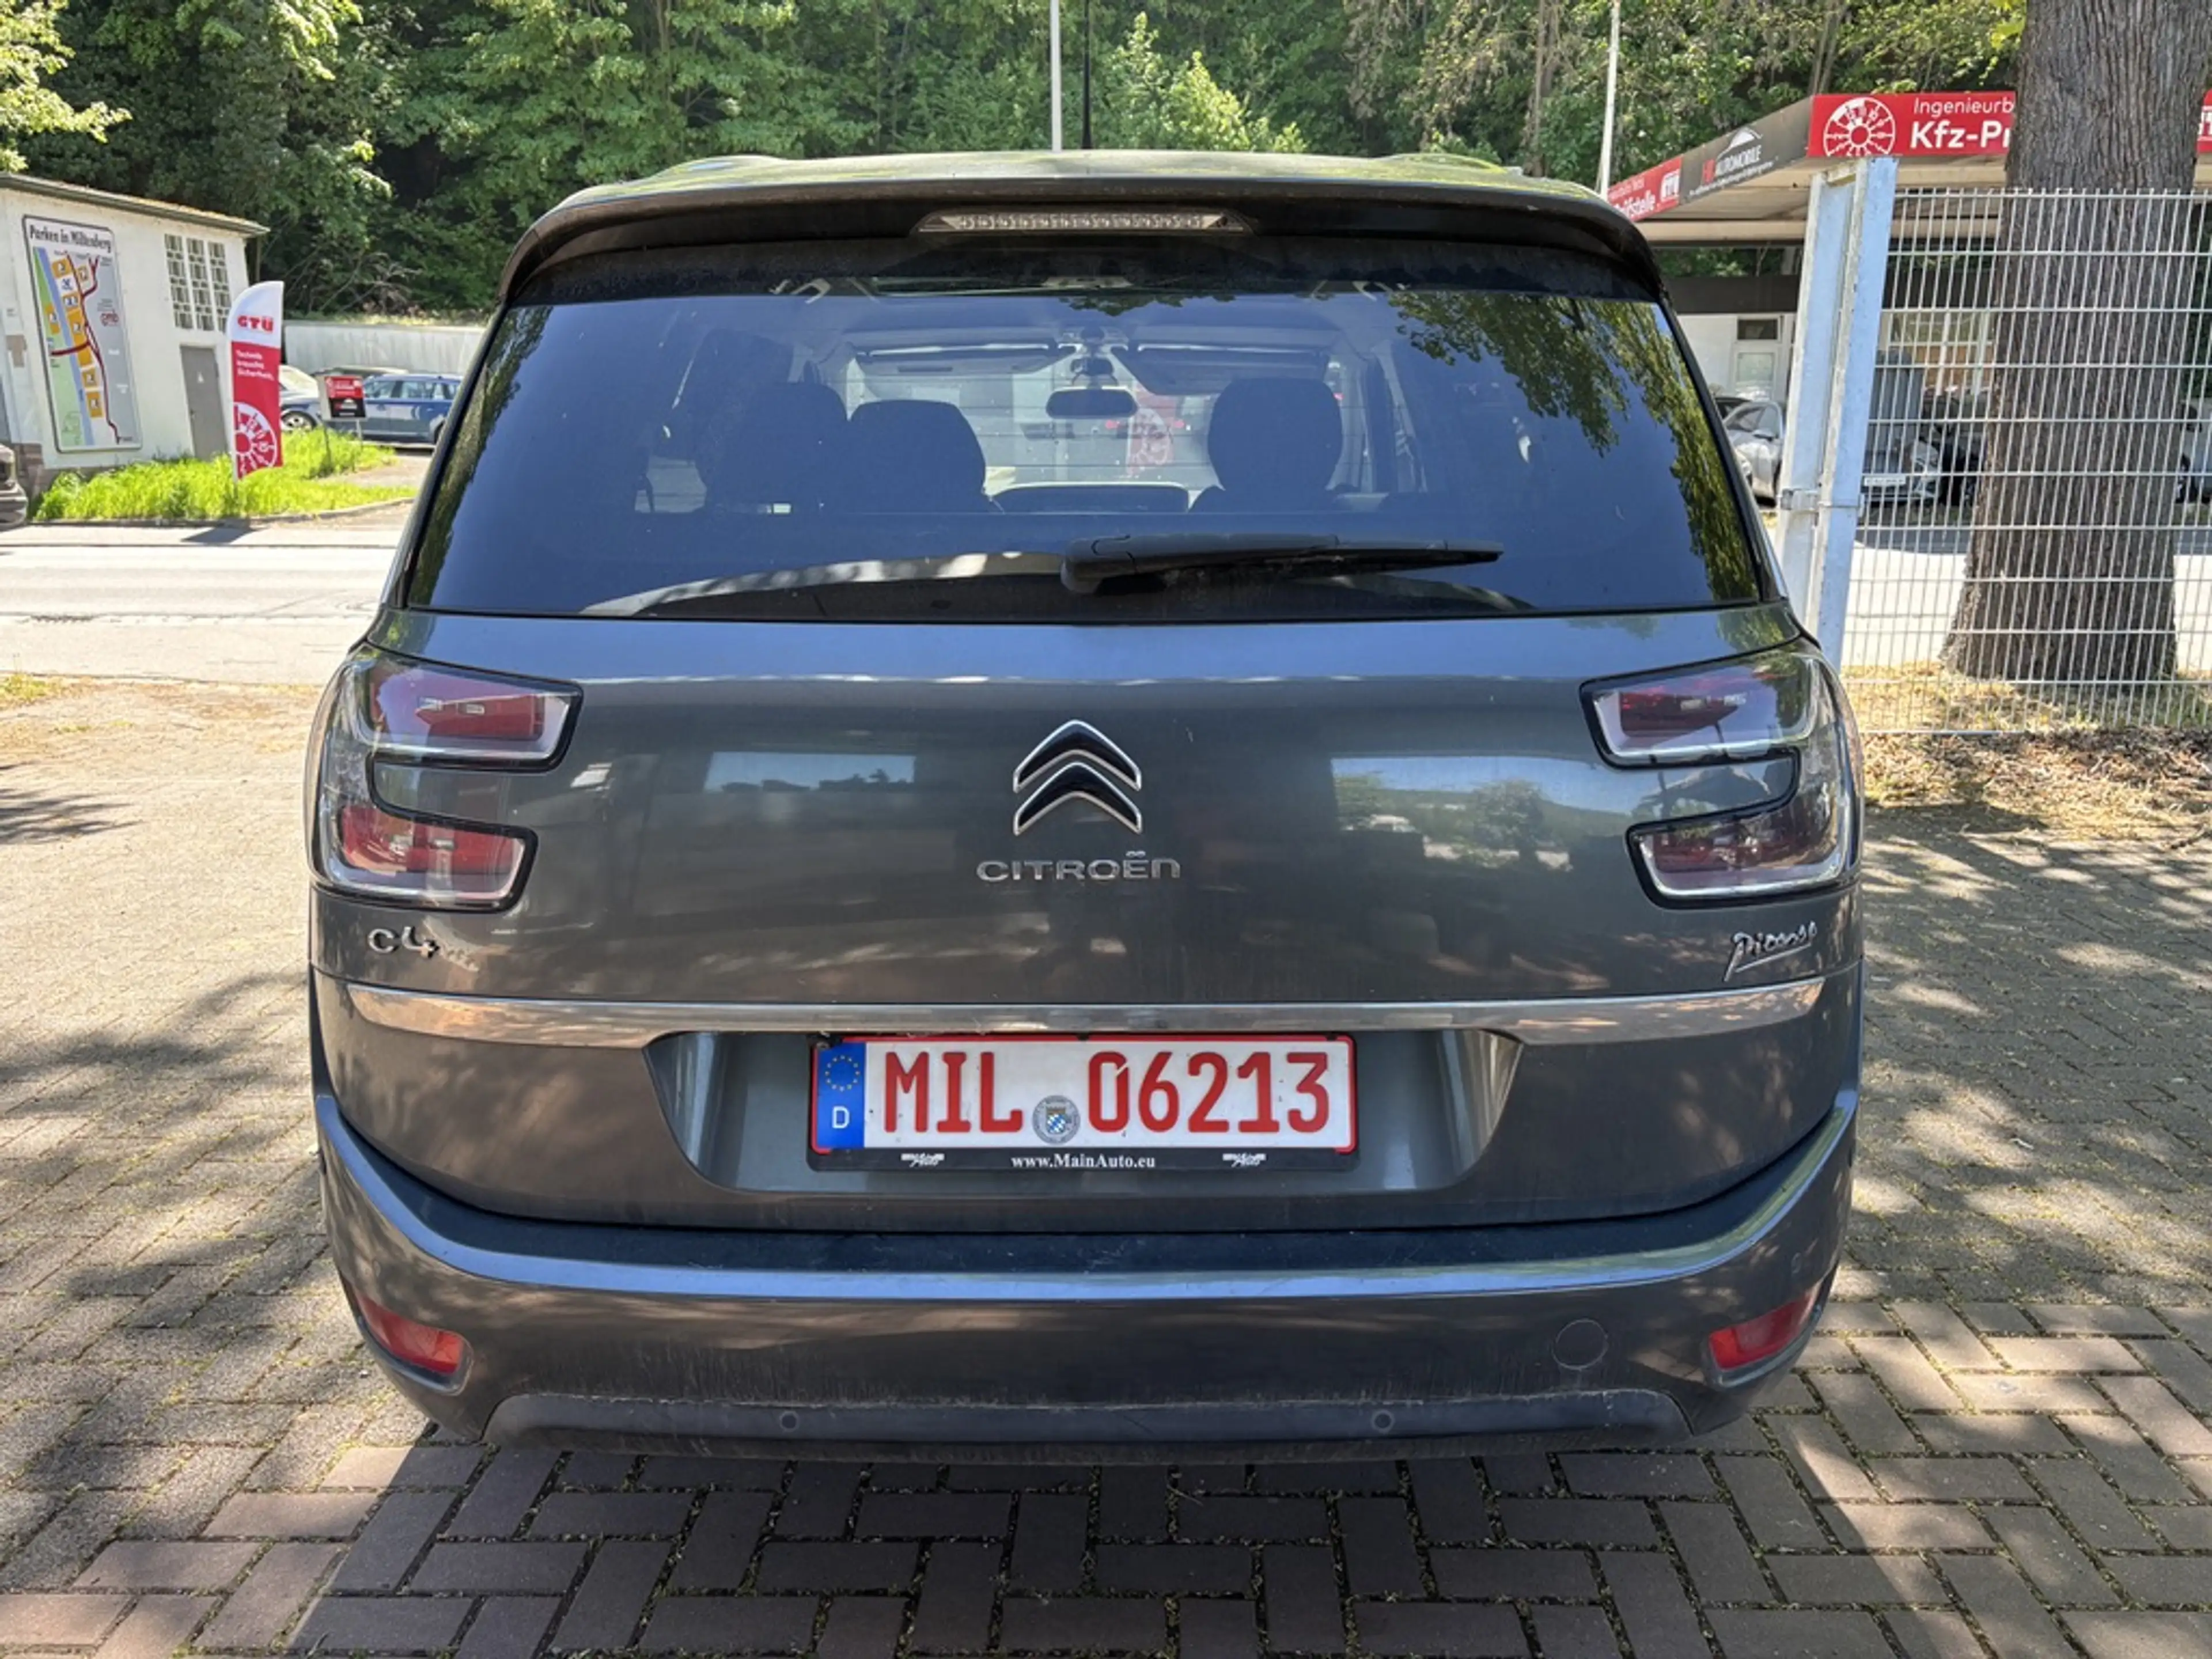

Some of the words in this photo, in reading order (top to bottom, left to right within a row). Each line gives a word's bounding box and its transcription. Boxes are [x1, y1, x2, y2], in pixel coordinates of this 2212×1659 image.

[237, 315, 274, 332] GTÜ
[976, 850, 1180, 882] CITROËN
[368, 926, 434, 957] C4
[884, 1052, 1023, 1132] MIL
[1088, 1051, 1330, 1132] 06213
[832, 1106, 850, 1129] D
[1011, 1154, 1156, 1169] www.MainAuto.eu
